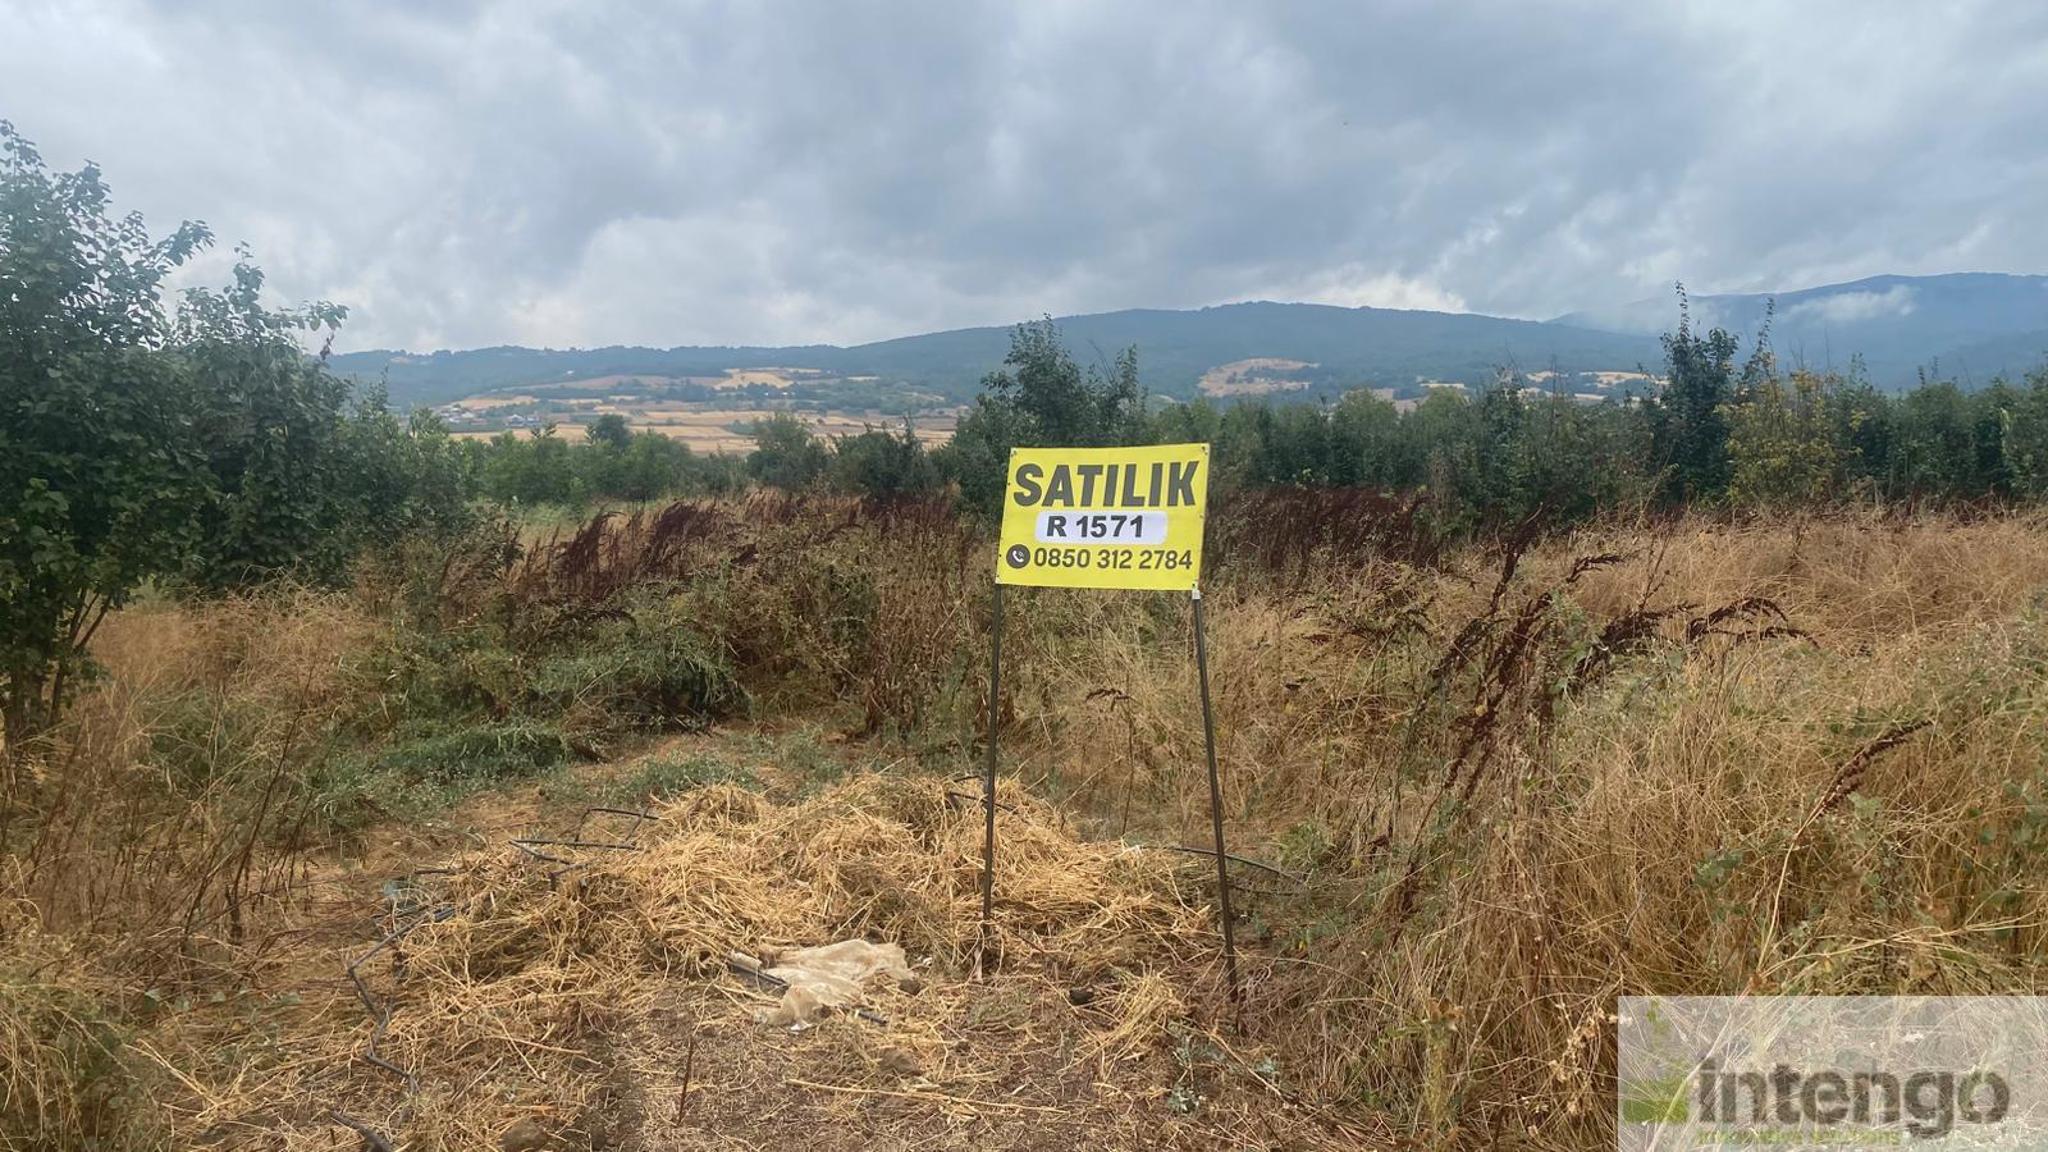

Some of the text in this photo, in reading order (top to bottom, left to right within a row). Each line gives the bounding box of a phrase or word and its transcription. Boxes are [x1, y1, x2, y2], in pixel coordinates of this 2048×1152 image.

[1013, 461, 1199, 507] SATILIK
[1046, 515, 1144, 538] R 1571
[1034, 548, 1193, 569] 0850 312 2784
